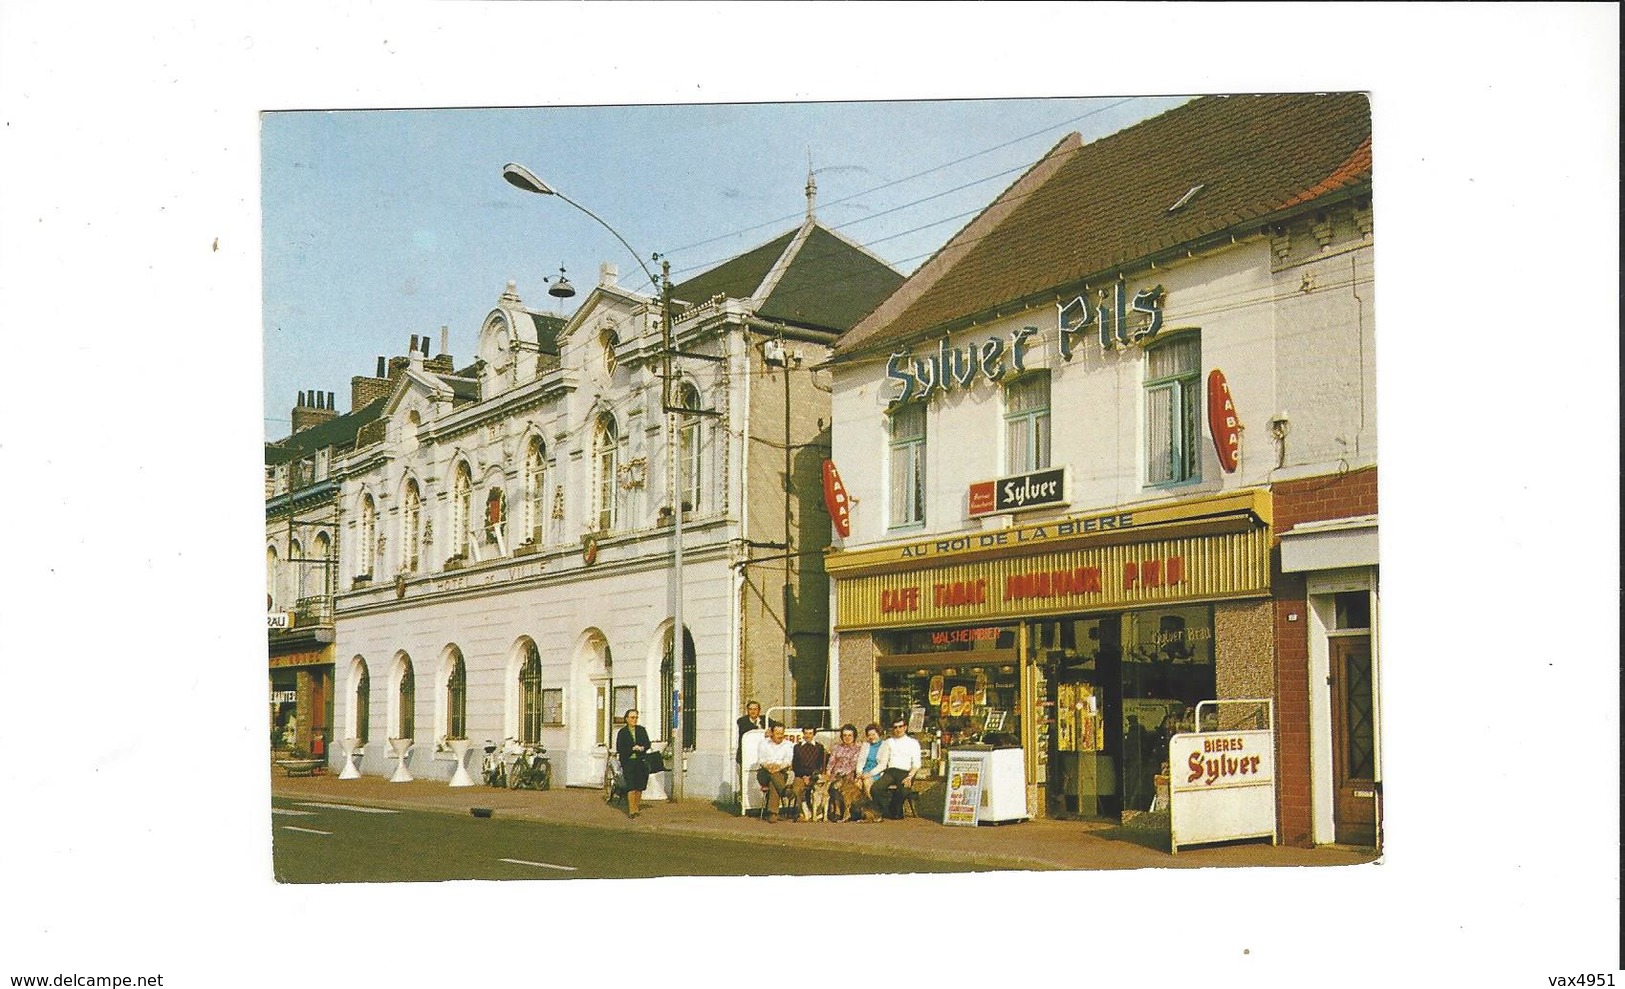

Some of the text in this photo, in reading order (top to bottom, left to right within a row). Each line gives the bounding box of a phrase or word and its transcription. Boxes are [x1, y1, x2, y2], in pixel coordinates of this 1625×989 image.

[886, 284, 1165, 402] Sylver Pils
[1221, 382, 1239, 461] TABAC
[831, 468, 849, 528] TABAC
[1003, 476, 1057, 506] Sylver
[901, 545, 928, 559] AU
[980, 531, 1008, 547] DE
[1017, 526, 1047, 543] LA
[934, 578, 986, 609] TABAC
[1004, 566, 1101, 601] JOURNAUX
[1187, 751, 1261, 786] Sylver
